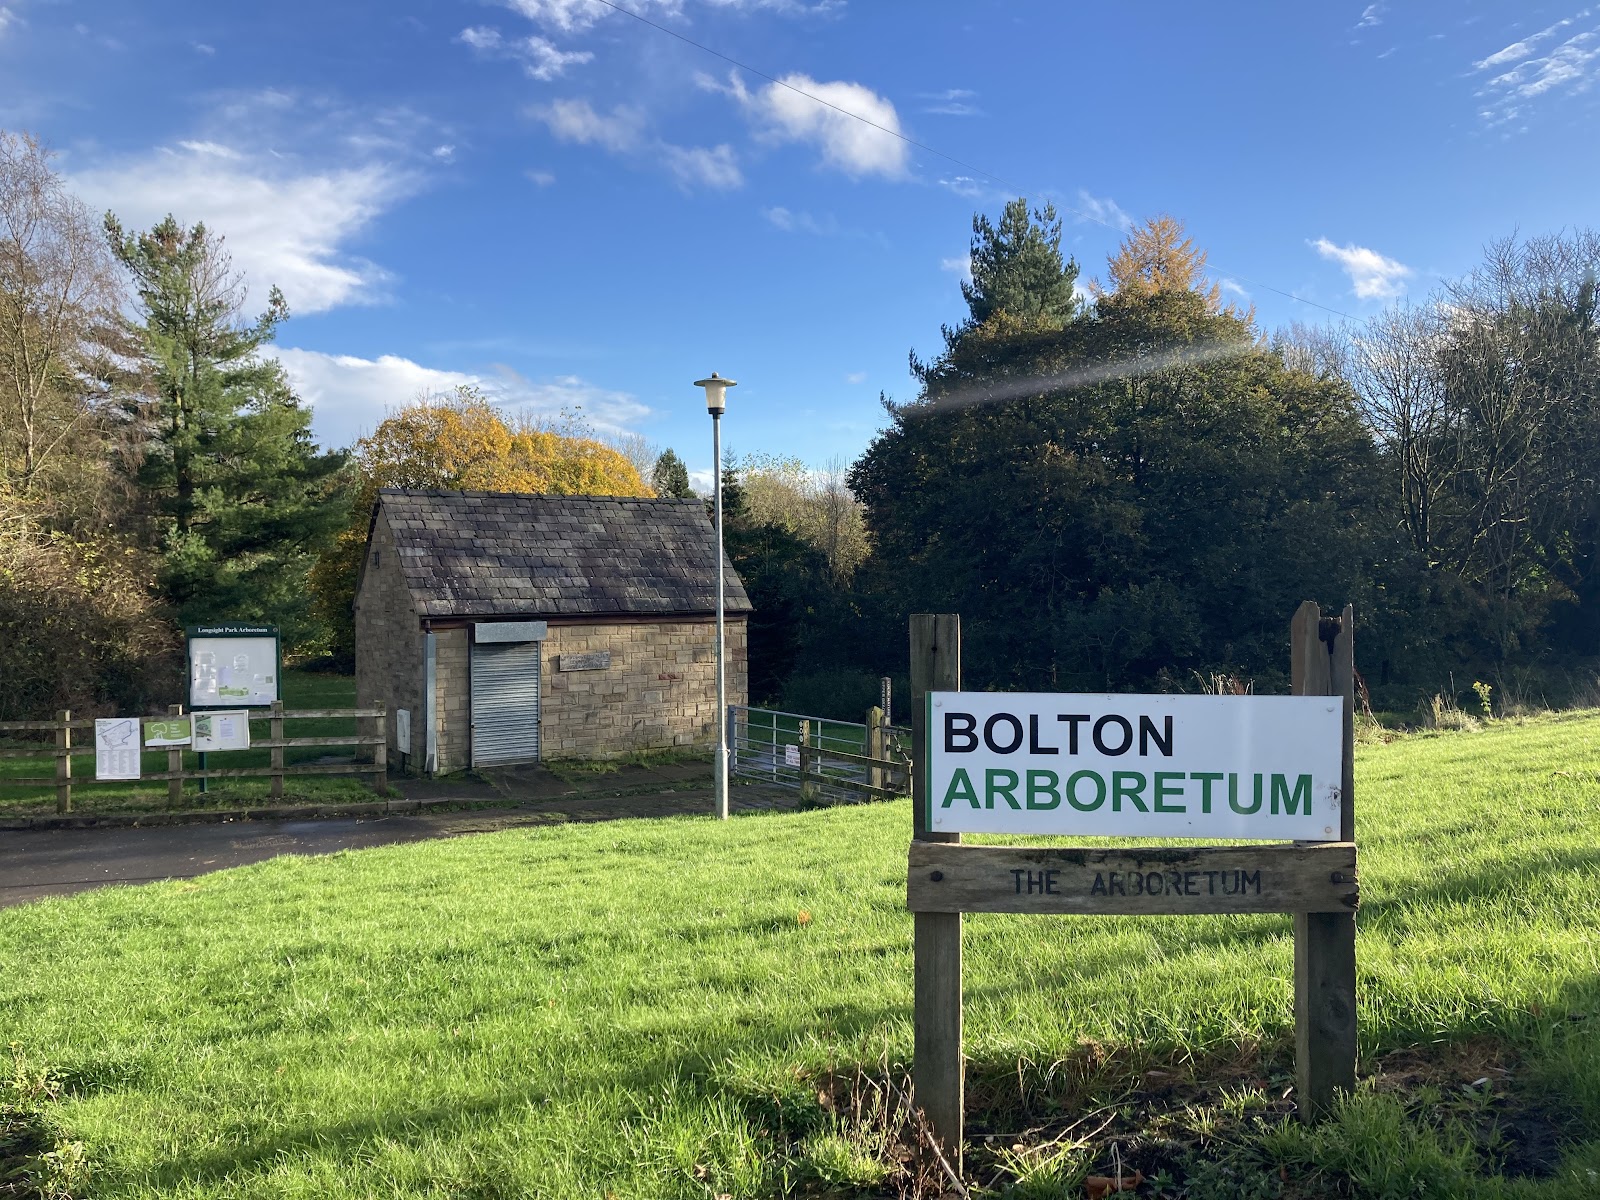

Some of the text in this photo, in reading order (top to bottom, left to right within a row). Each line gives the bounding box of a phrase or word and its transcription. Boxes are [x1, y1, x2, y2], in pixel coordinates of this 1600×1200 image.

[944, 712, 1174, 757] BOLTON
[941, 768, 1313, 816] ARBORETUM
[1010, 869, 1262, 897] THE ARBORETUM
